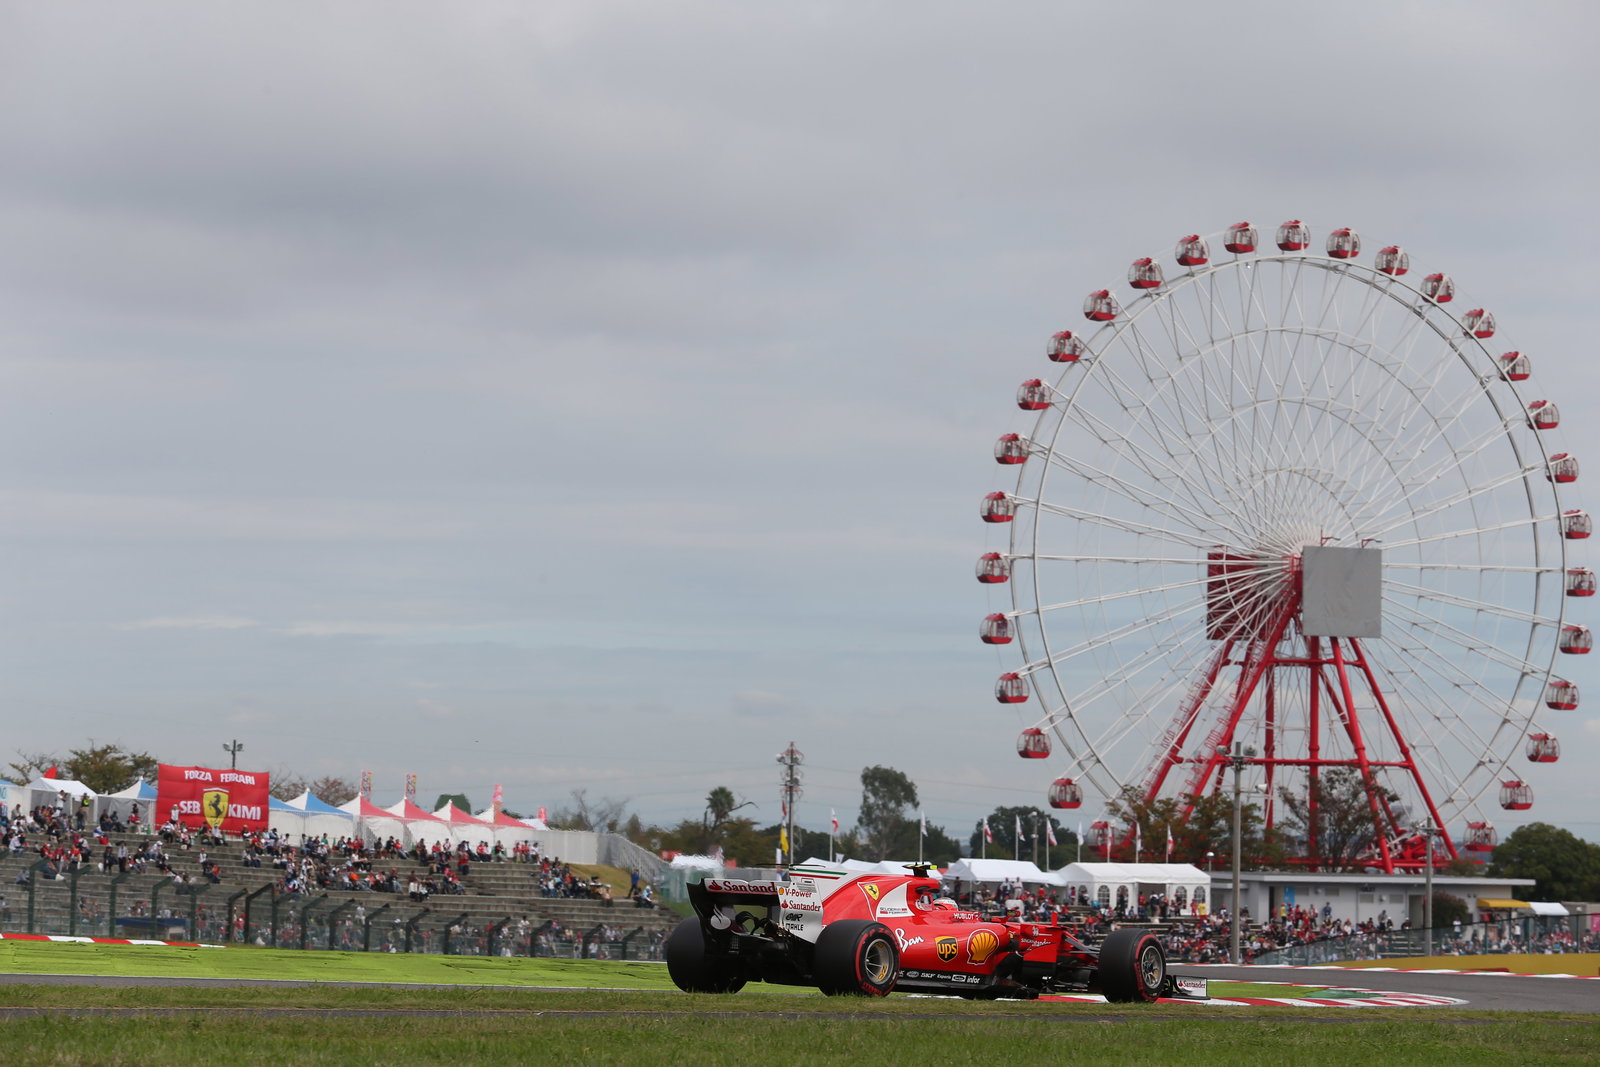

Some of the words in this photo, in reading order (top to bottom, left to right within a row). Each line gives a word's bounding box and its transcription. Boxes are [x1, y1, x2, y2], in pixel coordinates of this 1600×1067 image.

[184, 770, 212, 781] FORZA
[220, 772, 255, 785] FERRARI
[179, 800, 201, 814] SEB
[228, 804, 261, 820] KIMI
[723, 881, 777, 893] Santand
[785, 888, 812, 898] V-Power
[789, 900, 821, 912] Santander
[895, 928, 924, 952] Ban
[938, 943, 957, 959] ups
[1183, 980, 1206, 989] Santander
